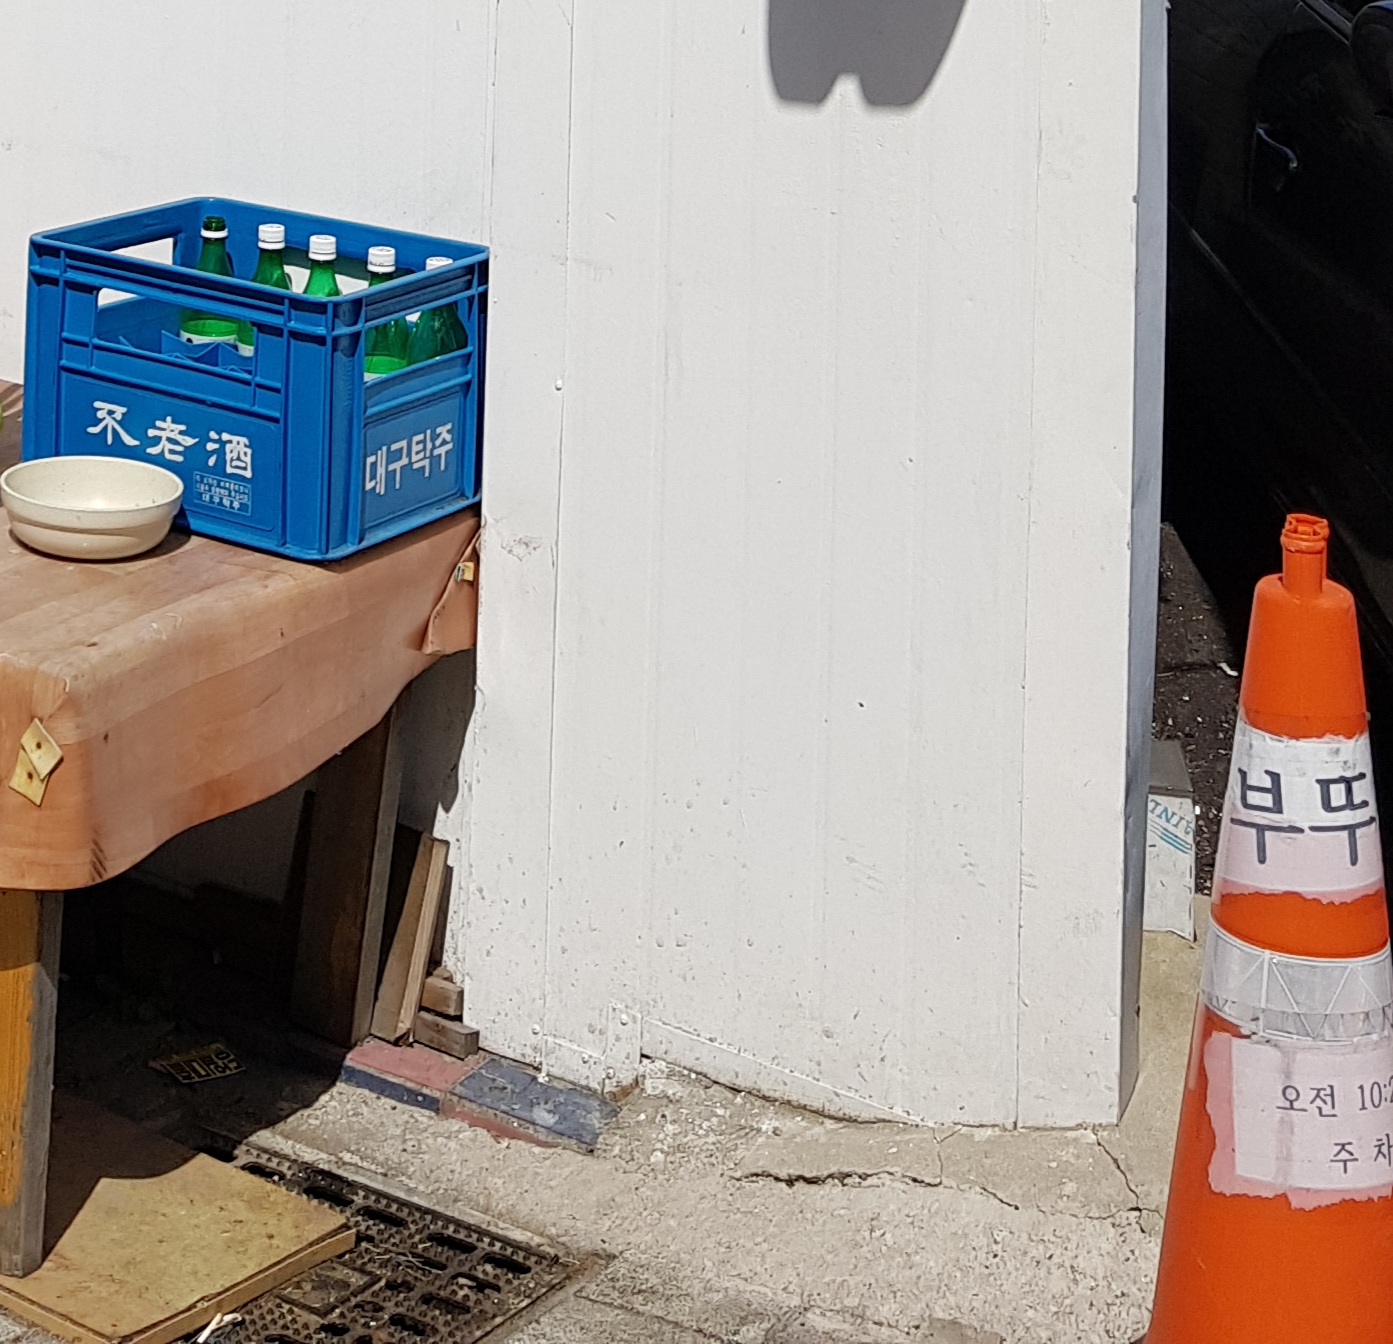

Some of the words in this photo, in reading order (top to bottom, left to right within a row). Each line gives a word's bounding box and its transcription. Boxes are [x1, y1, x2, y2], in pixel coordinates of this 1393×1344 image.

[85, 400, 254, 480] 不老酒
[364, 421, 455, 496] 대구탁주
[1228, 766, 1377, 867] 부뚜
[1276, 1082, 1339, 1119] 오전
